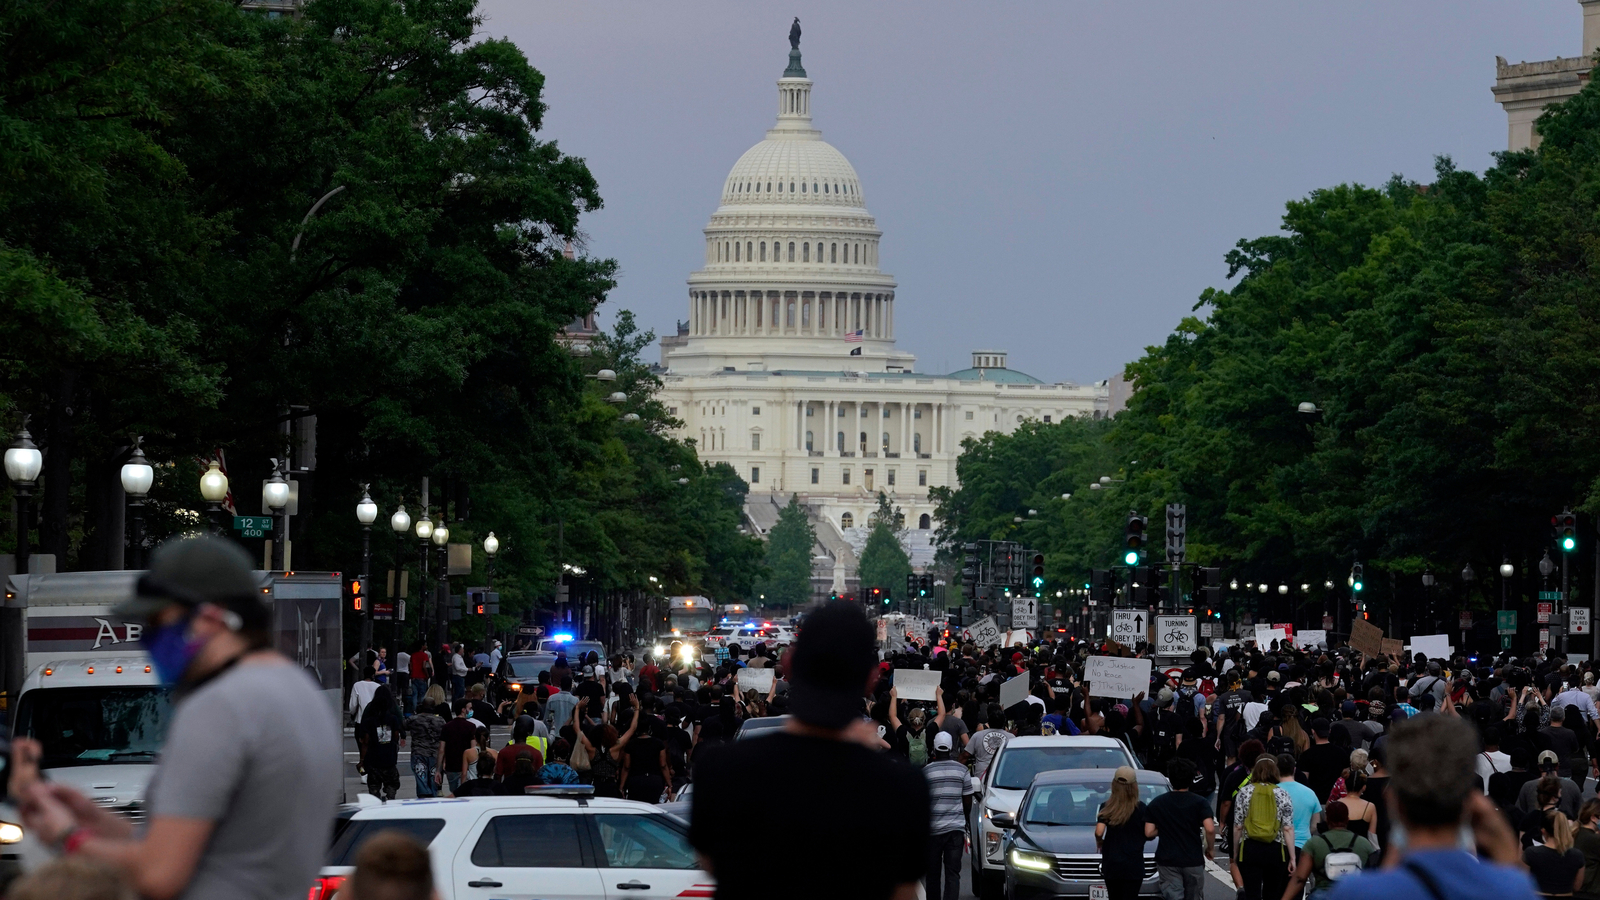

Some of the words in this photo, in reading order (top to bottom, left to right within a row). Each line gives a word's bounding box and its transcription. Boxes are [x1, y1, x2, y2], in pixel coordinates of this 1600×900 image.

[241, 518, 254, 528] 12
[91, 617, 143, 650] AB
[297, 604, 322, 683] ABLE
[1115, 634, 1130, 642] OBEY
[1132, 634, 1146, 642] THIS
